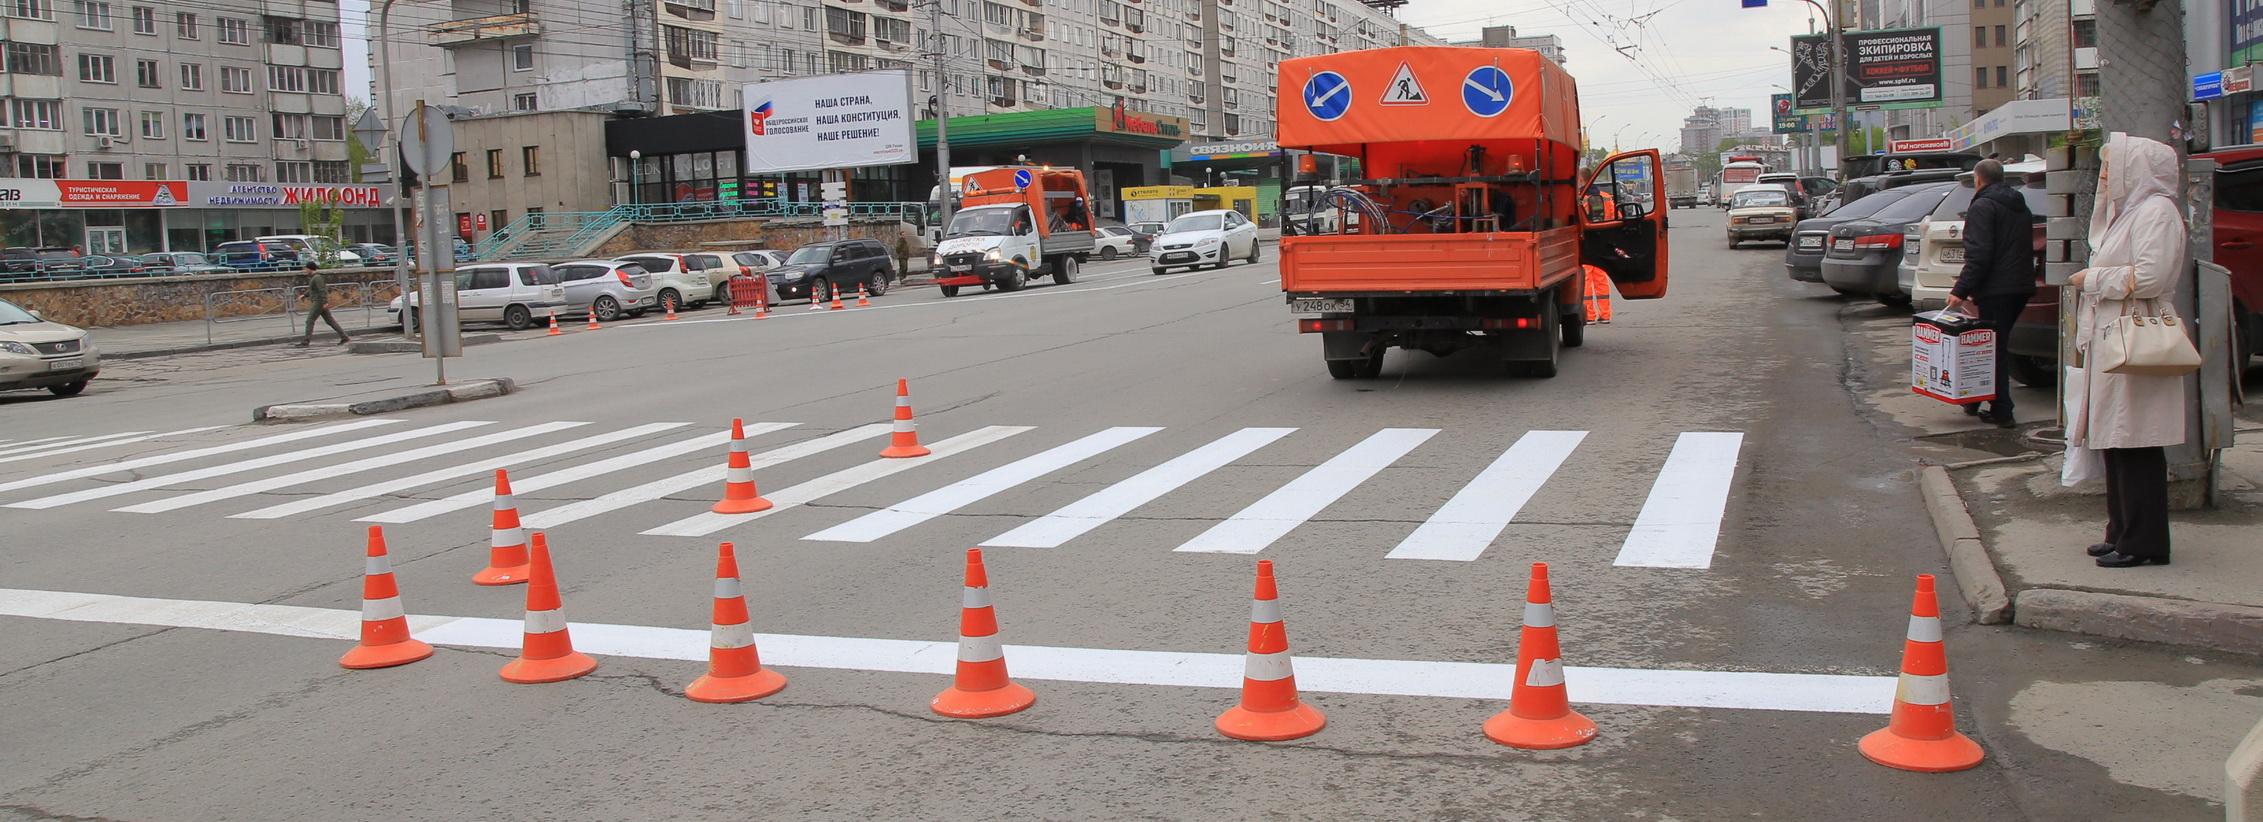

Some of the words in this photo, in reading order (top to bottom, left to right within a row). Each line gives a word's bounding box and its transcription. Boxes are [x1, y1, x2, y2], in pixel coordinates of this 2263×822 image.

[1858, 35, 1932, 46] ПРОФЕССИОНАЛЬНАЯ
[1858, 42, 1933, 56] ЭКИПИРОВКА
[1873, 54, 1893, 62] ДЕТЕЙ
[1900, 52, 1933, 60] ВЗРОСЛЫХ
[815, 98, 839, 109] НАША
[840, 95, 873, 107] СТРАНА,
[816, 113, 840, 125] НАША
[841, 109, 902, 123] КОНСТИТУЦИЯ,
[766, 124, 809, 135] ГОЛОСОВАНИЕ
[817, 130, 840, 142] НАШЕ
[841, 127, 880, 140] РЕШЕНИЕ!
[231, 186, 278, 194] АГЕНТСТВО
[208, 197, 279, 206] НЕДВИЖИМОСТИ
[1916, 324, 1940, 342] HAMMER
[1961, 331, 1991, 345] HAMMER
